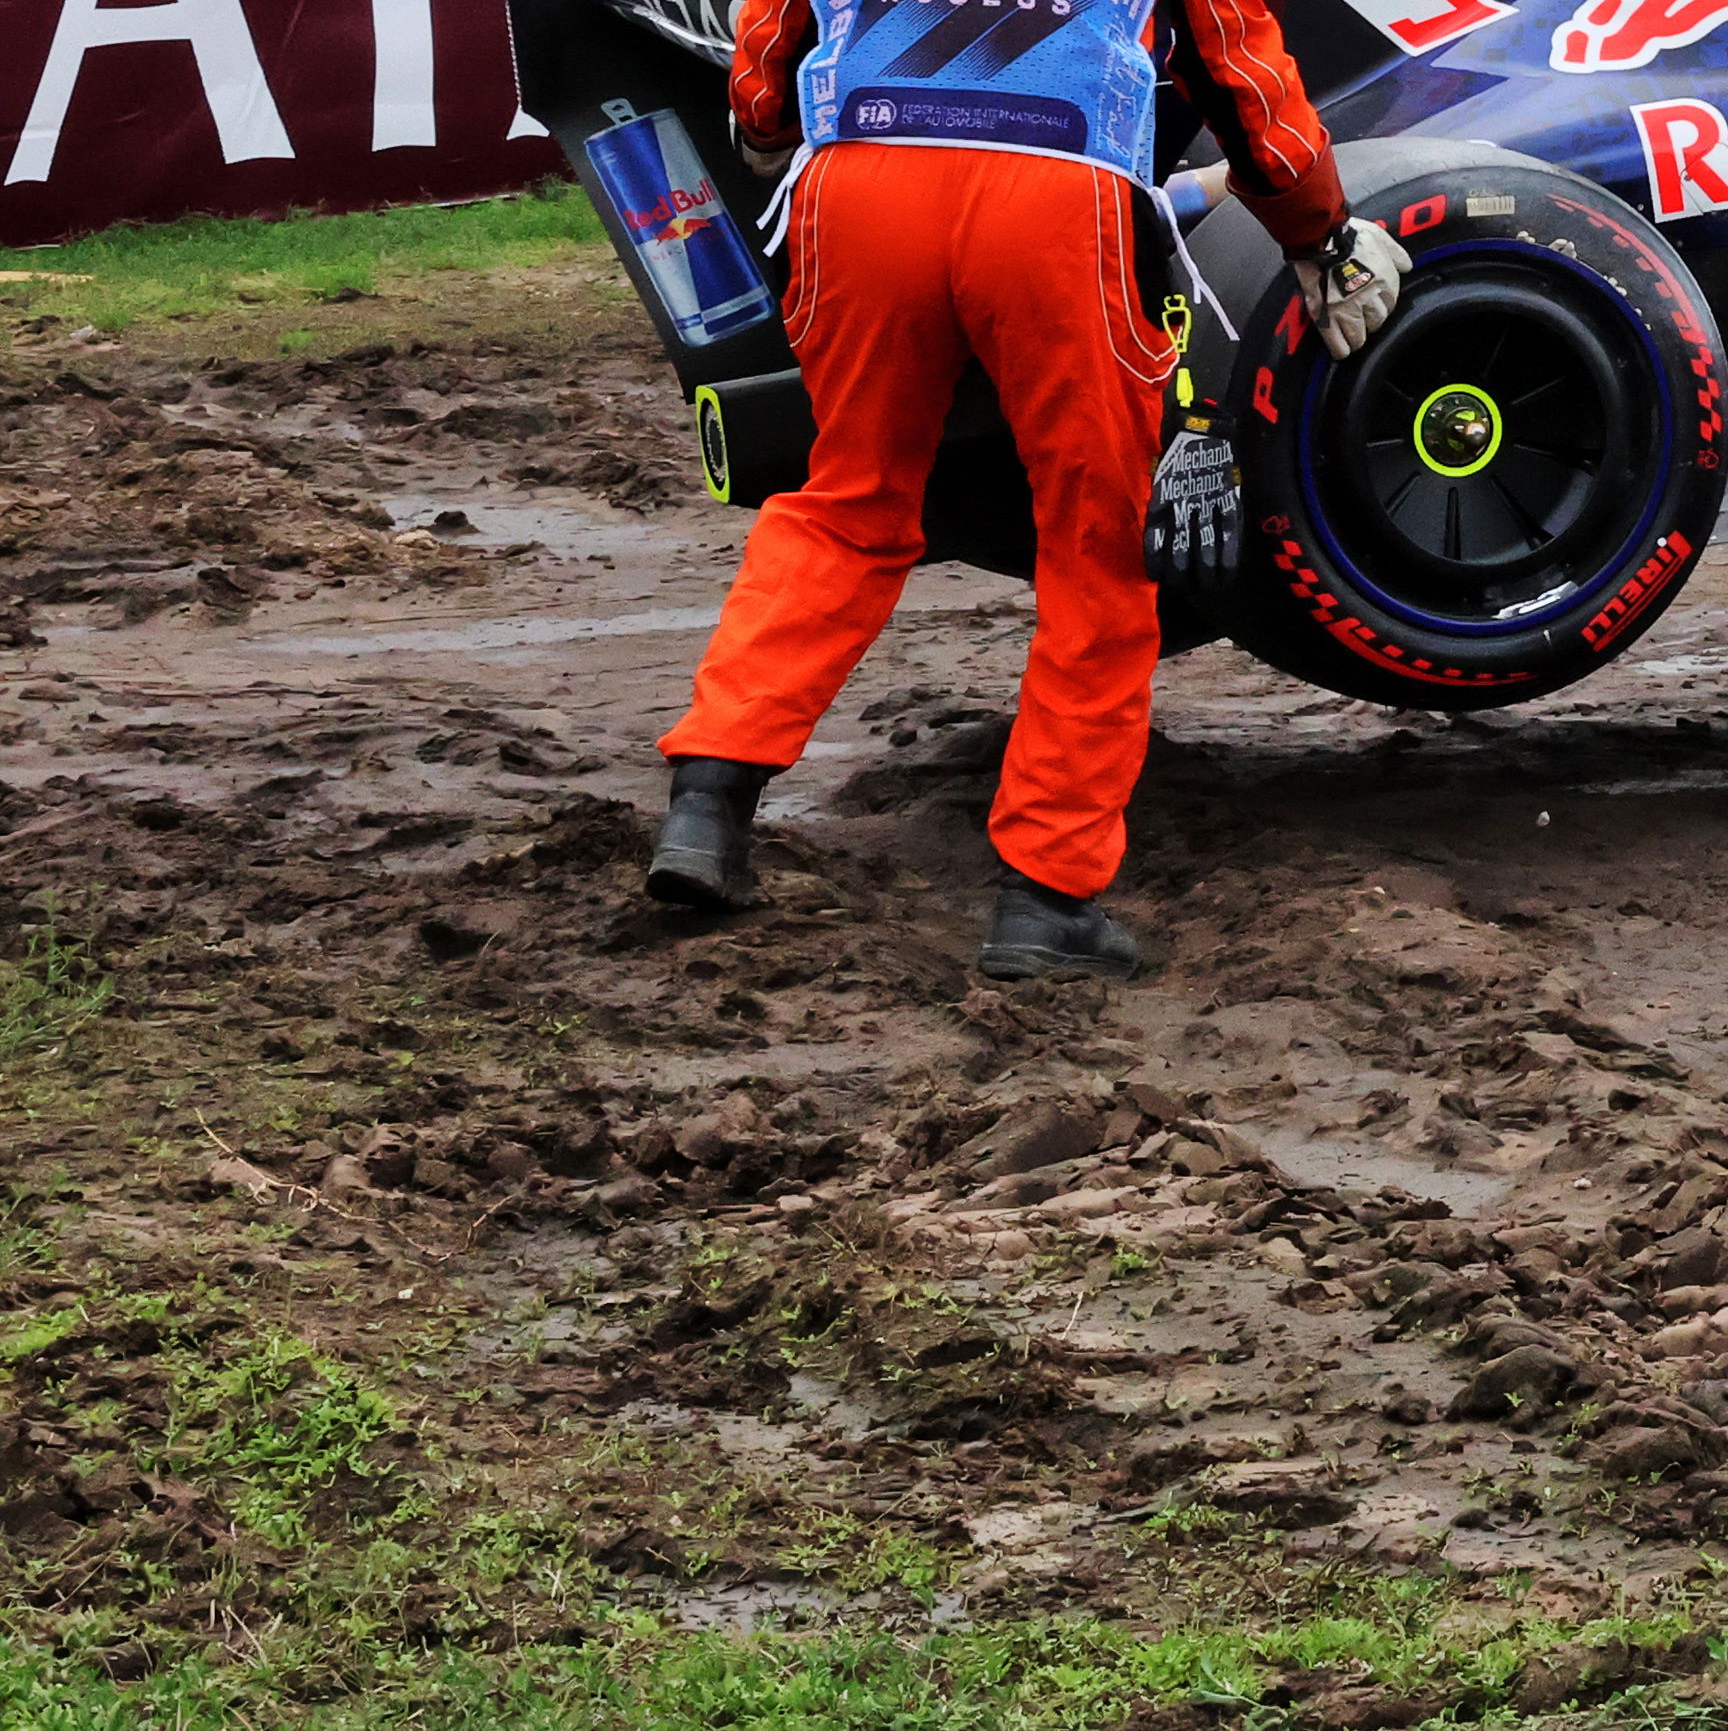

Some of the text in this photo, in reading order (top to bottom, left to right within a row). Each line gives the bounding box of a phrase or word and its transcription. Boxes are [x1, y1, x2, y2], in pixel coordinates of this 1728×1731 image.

[1252, 193, 1448, 425] P ZO
[1580, 530, 1694, 653] PIRELLI
